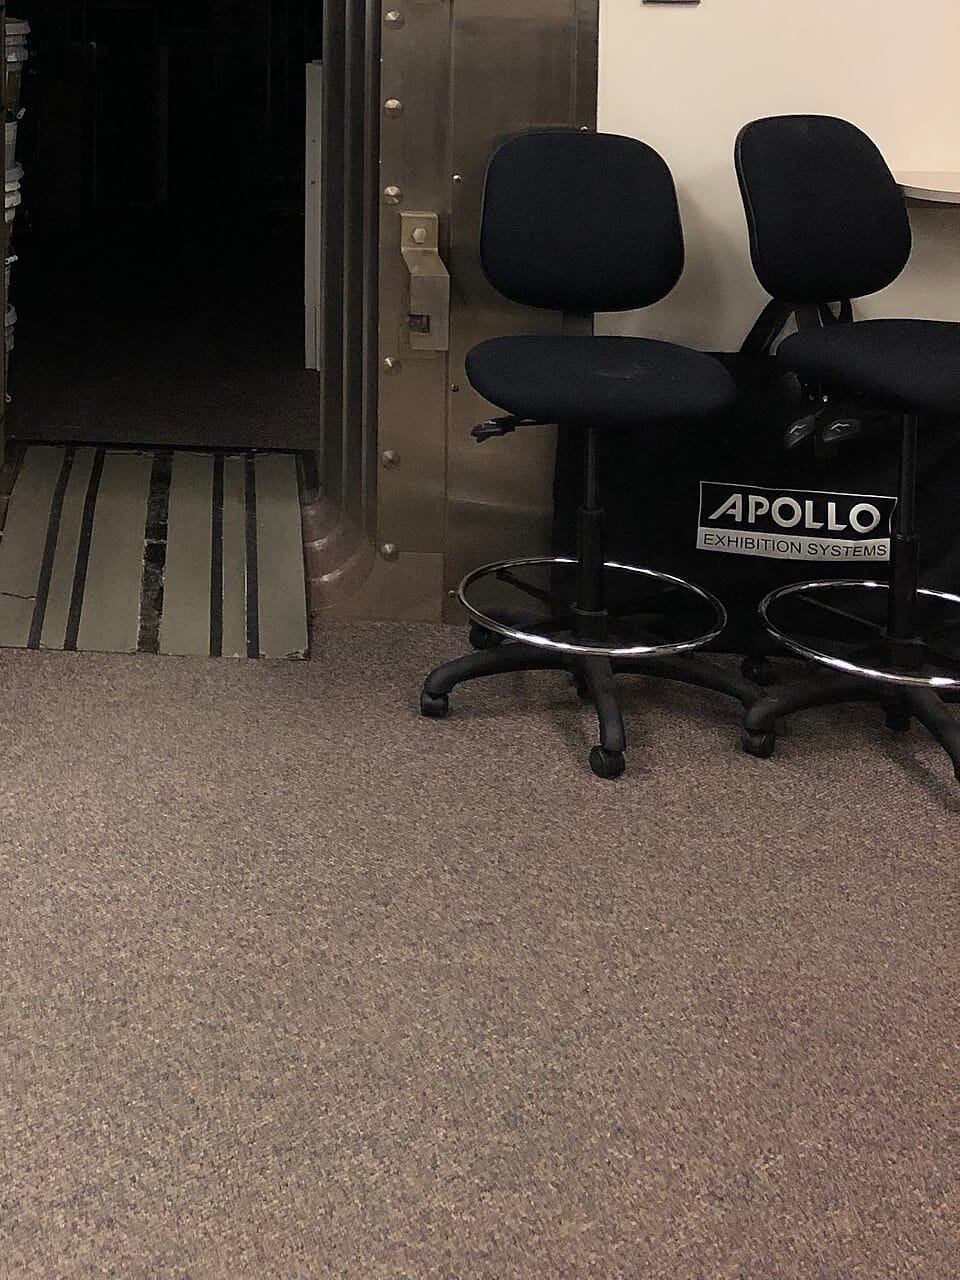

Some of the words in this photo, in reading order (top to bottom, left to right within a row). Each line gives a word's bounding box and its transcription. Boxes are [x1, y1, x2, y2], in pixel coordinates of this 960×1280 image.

[708, 493, 881, 534] APOLLO
[703, 533, 802, 554] EXHIBITION
[807, 543, 887, 557] SYSTEMS
